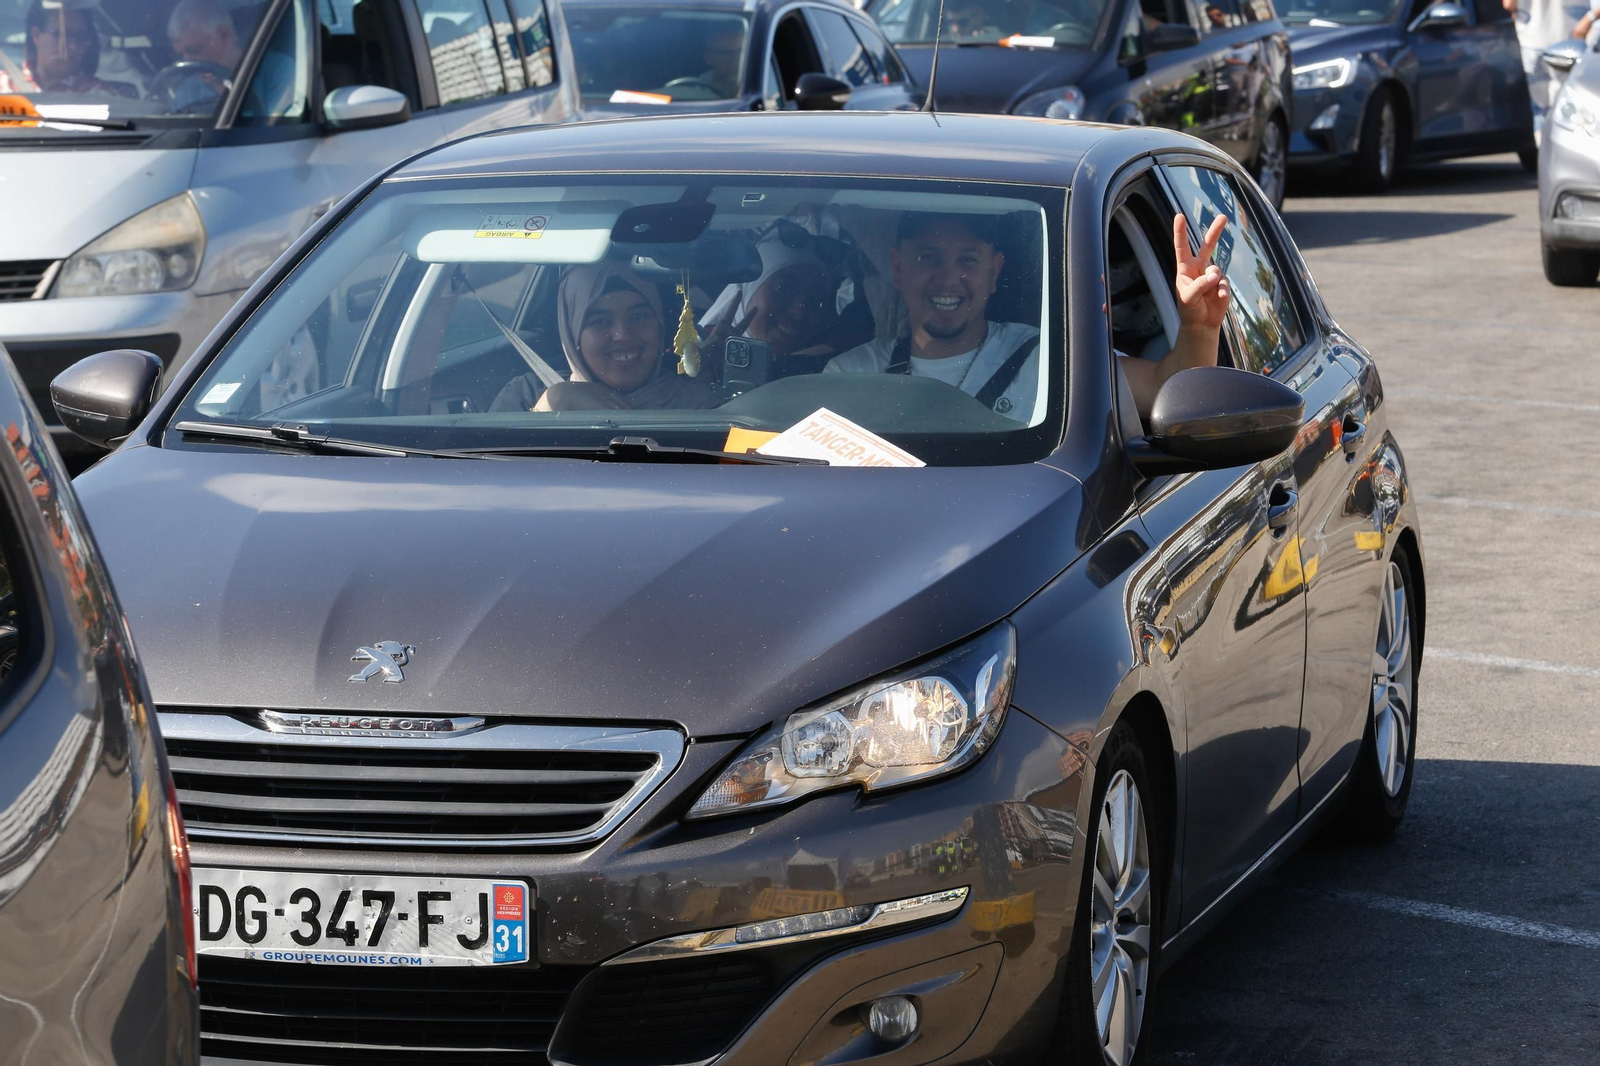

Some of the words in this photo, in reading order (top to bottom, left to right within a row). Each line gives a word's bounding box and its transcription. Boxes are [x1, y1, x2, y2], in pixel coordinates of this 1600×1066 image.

[300, 715, 433, 731] PEUGEOT
[199, 885, 489, 950] DG-347-FJ
[496, 924, 523, 953] 31
[263, 951, 422, 966] GROUPEMOUNÈS.COM
